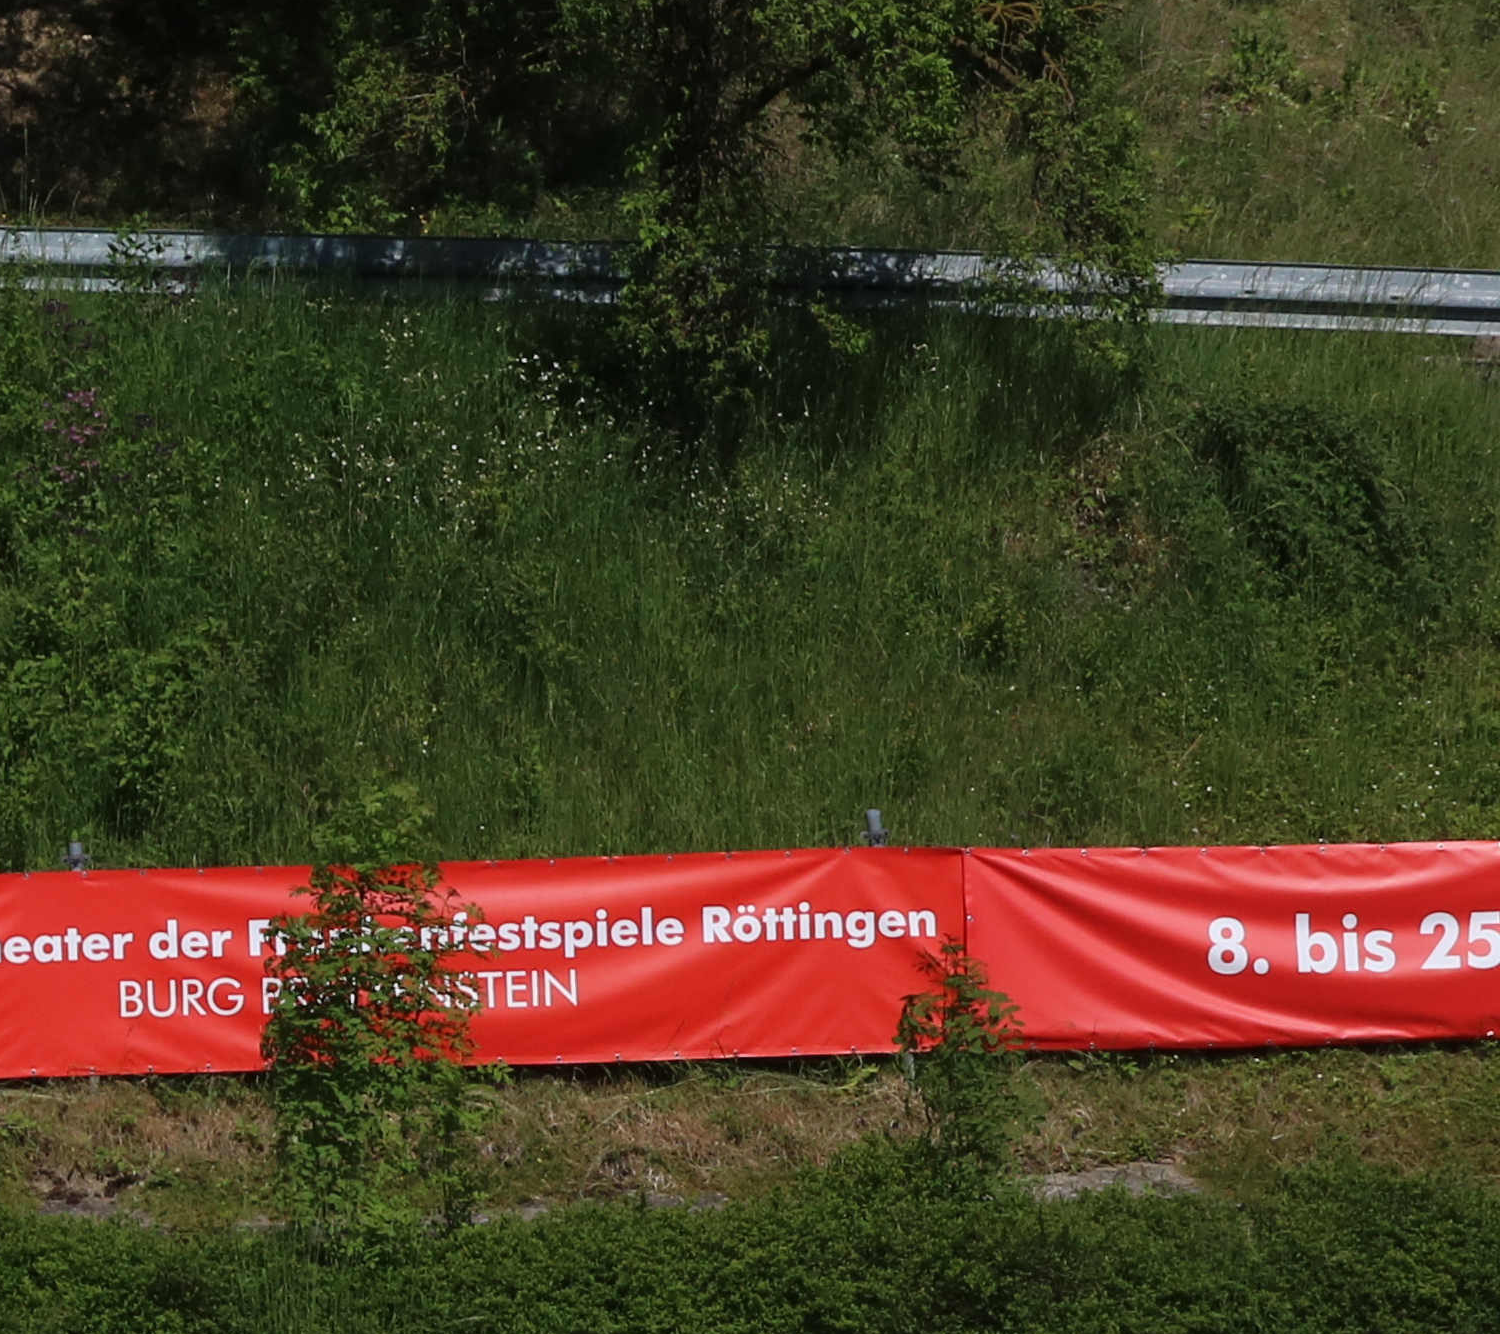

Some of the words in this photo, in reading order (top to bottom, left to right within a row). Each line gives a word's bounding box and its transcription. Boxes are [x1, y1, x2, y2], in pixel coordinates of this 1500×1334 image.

[148, 919, 232, 960] der
[248, 906, 685, 958] Frenfestspiele
[702, 901, 937, 948] Röttingen
[1207, 917, 1270, 975] 8.
[1295, 913, 1397, 974] bis
[119, 977, 245, 1018] BURG
[262, 968, 578, 1014] BNSTEIN
